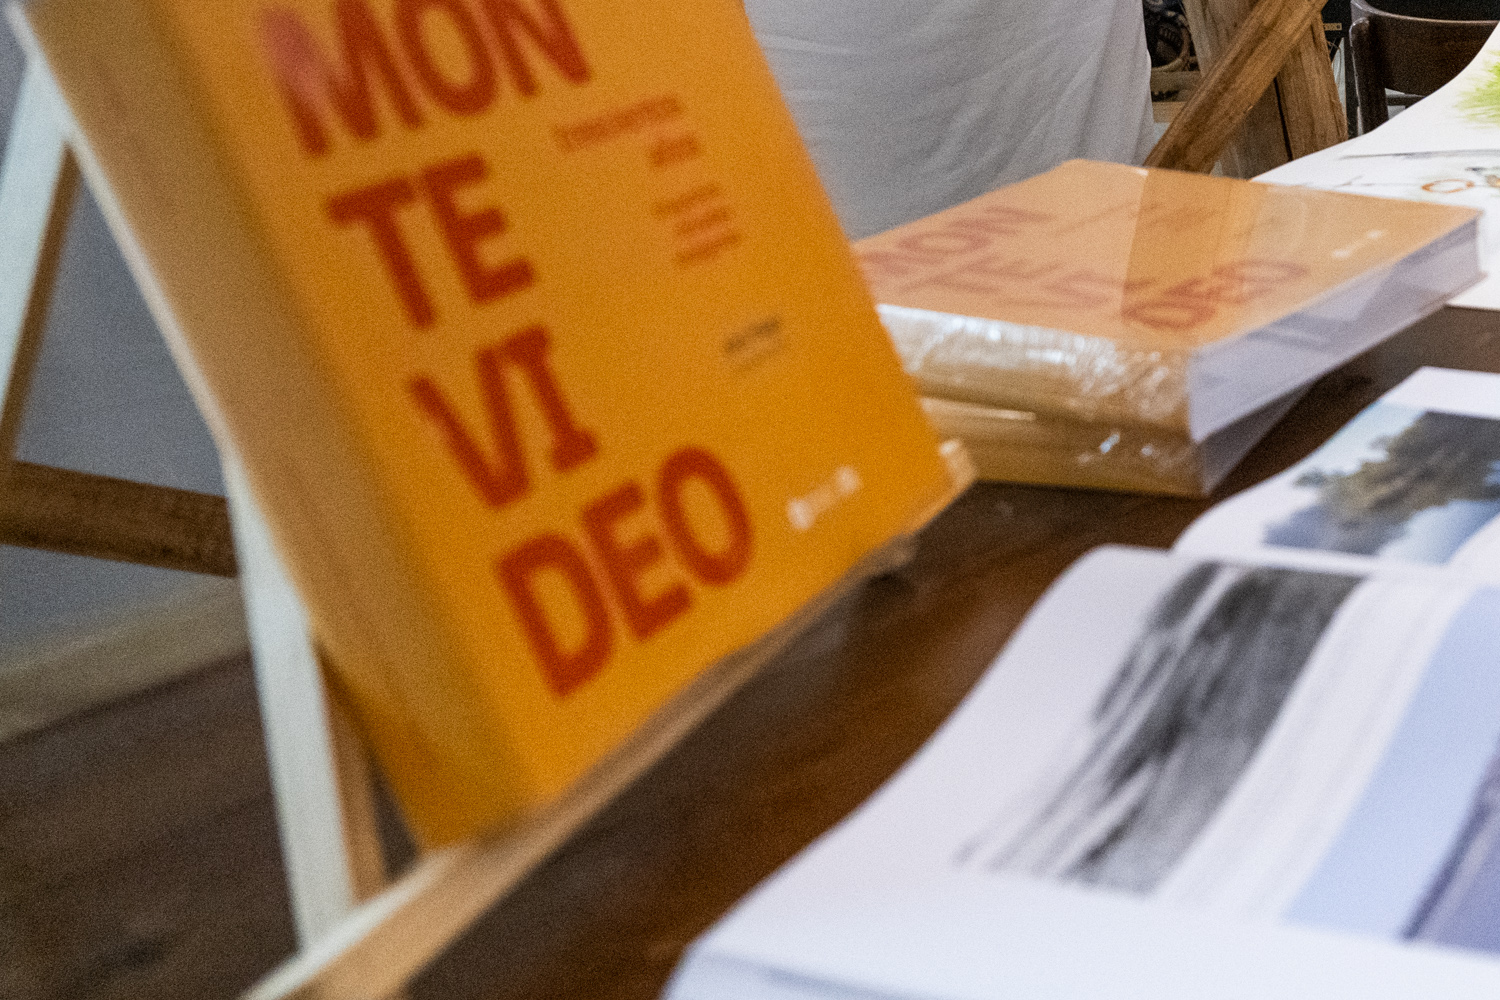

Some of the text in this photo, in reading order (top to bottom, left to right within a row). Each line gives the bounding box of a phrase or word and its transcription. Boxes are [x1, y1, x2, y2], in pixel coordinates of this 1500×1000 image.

[326, 151, 538, 331] TE
[406, 325, 600, 510] VI
[493, 446, 756, 698] DEO
